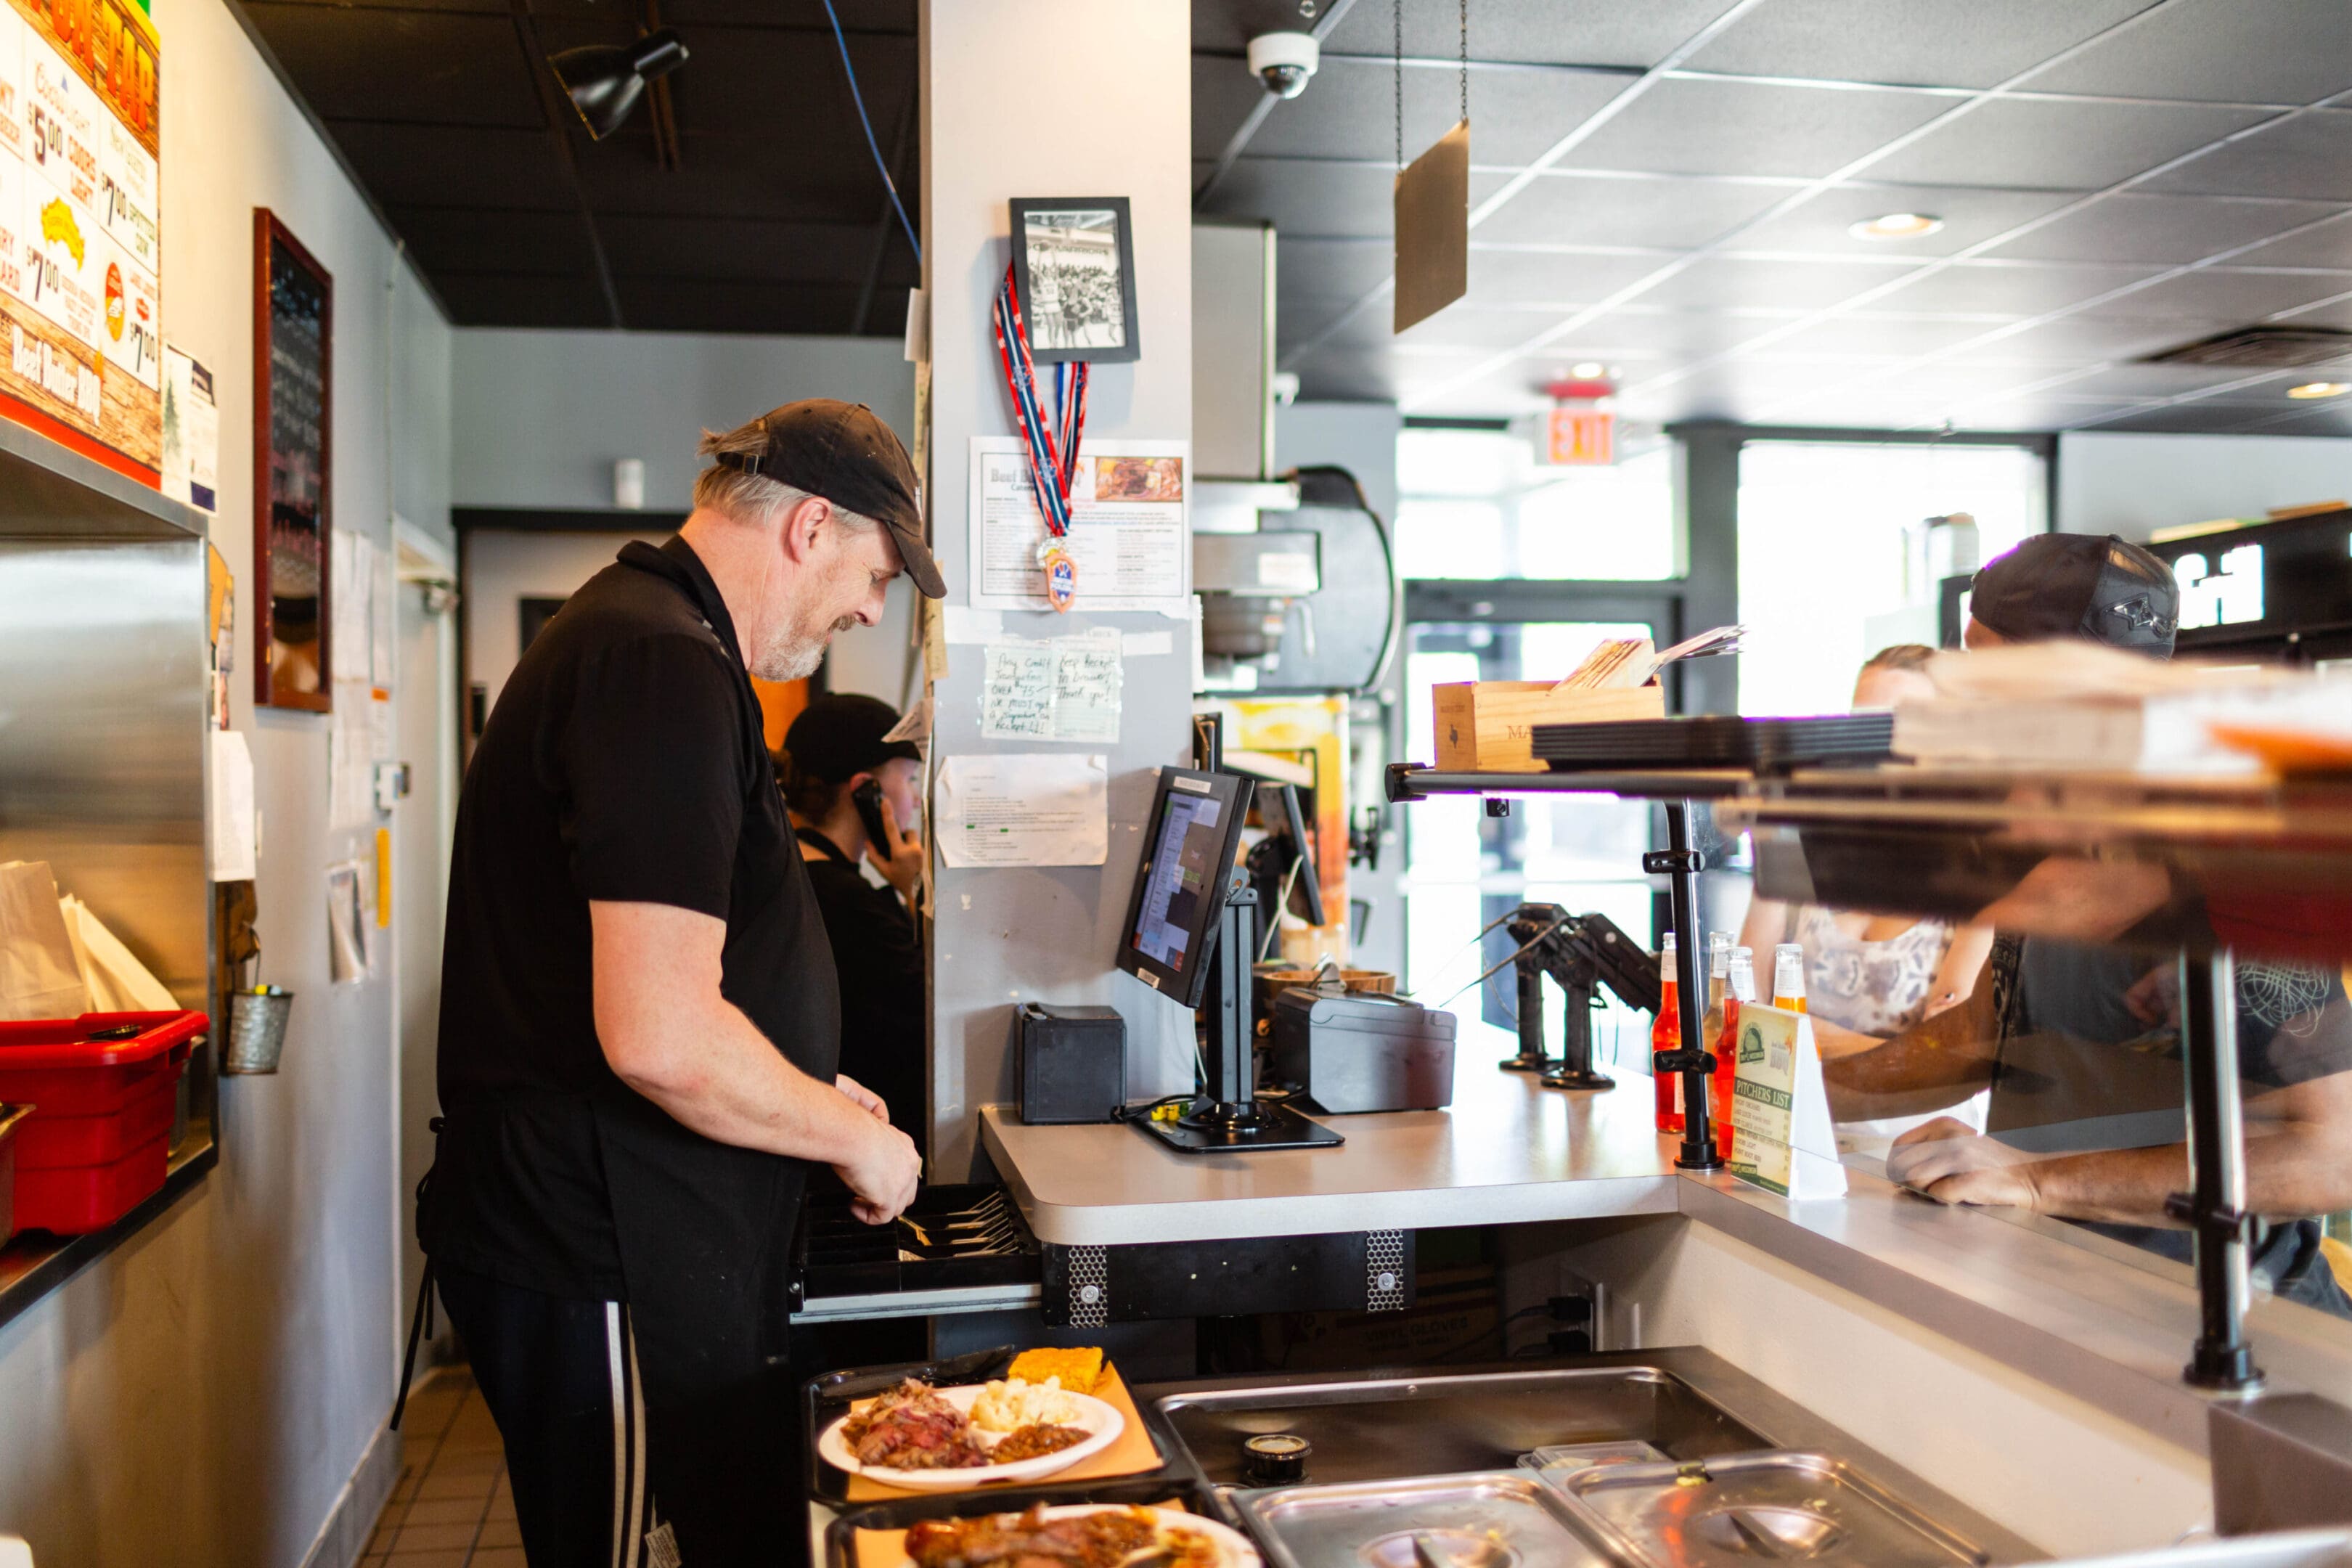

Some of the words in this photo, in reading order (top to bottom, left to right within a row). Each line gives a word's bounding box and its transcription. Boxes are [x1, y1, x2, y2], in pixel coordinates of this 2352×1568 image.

[102, 0, 154, 132] TAP
[12, 324, 42, 385] Beef
[43, 342, 77, 404] Butter
[77, 364, 101, 428] BBQ
[1552, 415, 1612, 460] EXIT
[991, 467, 1017, 483] Beef
[1008, 698, 1034, 709] MUST
[1055, 685, 1085, 700] Thank
[1736, 1079, 1771, 1103] PITCHERS
[1773, 1090, 1790, 1108] LIST
[1365, 1328, 1405, 1342] VINYL
[1410, 1315, 1469, 1336] GLOVES
